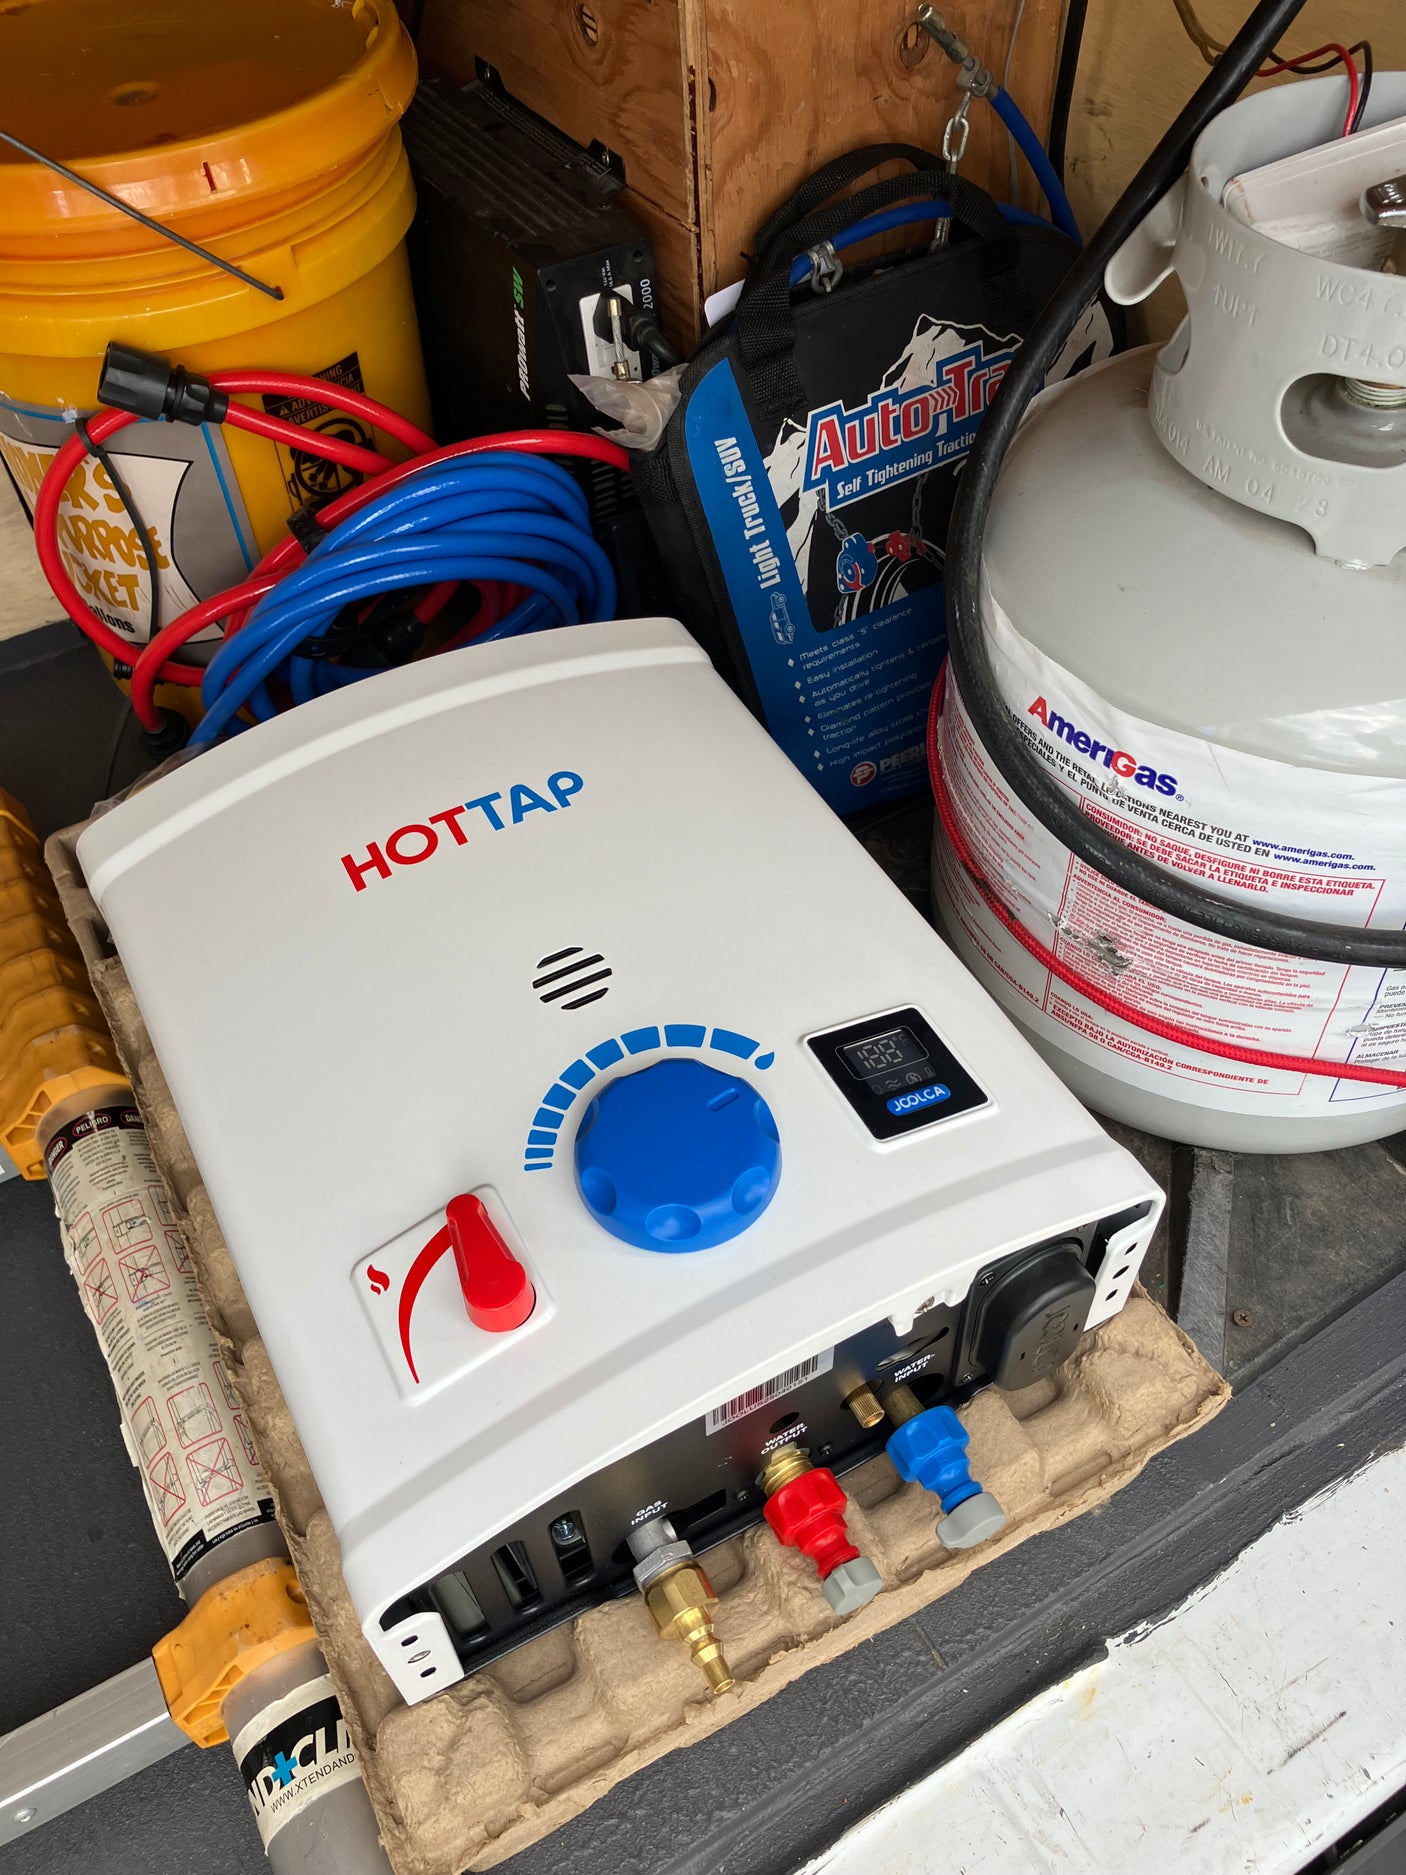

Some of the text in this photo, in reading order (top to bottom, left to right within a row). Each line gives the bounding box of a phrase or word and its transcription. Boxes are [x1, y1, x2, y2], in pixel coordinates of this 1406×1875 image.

[640, 278, 654, 310] 2000
[811, 394, 932, 481] Auto
[836, 476, 862, 499] Self
[866, 449, 933, 487] Tightening
[1203, 456, 1231, 485] AM
[1245, 478, 1274, 504] 04
[714, 436, 782, 590] Light Truck/SUV
[800, 607, 912, 662] Meets class clearance
[803, 641, 861, 670] requirements
[806, 648, 879, 685] Easy installation
[811, 669, 869, 698] Automatically
[870, 653, 906, 672] tightens
[814, 679, 870, 707] as you drive
[817, 698, 863, 719] Eliminates
[820, 713, 862, 733] Diamond
[863, 697, 895, 717] pattern
[822, 724, 858, 741] traction
[868, 725, 889, 739] alloy
[852, 742, 882, 759] impact
[1012, 715, 1038, 740] OFFERS
[1037, 736, 1055, 754] AND
[1055, 750, 1071, 768] THE
[1159, 808, 1208, 832] NEAREST
[1210, 824, 1233, 839] YOU
[1236, 832, 1250, 843] AT
[1252, 838, 1355, 861] www.amerigas.com.
[340, 771, 584, 893] HOTTAP
[1058, 764, 1065, 774] Y
[1067, 768, 1078, 783] EL
[1080, 778, 1109, 802] PUNTO
[1112, 798, 1126, 810] DE
[1127, 805, 1159, 824] VENTA
[1161, 818, 1196, 839] CERCA
[1198, 832, 1213, 844] DE
[1216, 836, 1252, 854] USTED
[1254, 846, 1270, 858] EN
[1273, 852, 1377, 871] www.amerigas.com.
[1084, 810, 1354, 897] PROVEEDOR: SE DEBE SACAR LA ETIQUETA E INSPECCIONAR
[1086, 803, 1376, 891] CONSUMIDOR: NO SAQUE, DESFIGURE NI BORRE ESTA ETIQUETA.
[1088, 872, 1098, 882] USE
[1127, 841, 1155, 860] ANTES
[1156, 854, 1169, 865] DE
[1171, 858, 1205, 879] VOLVER
[1218, 876, 1269, 894] LLENARLO.
[1072, 874, 1112, 899] ADVERTENCIA
[1051, 1010, 1088, 1035] ANSI/NFPA
[1088, 1031, 1098, 1041] 58
[1107, 1041, 1172, 1070] CAN/CGA-B149.2
[1052, 1004, 1083, 1026] EXCEPTO
[1084, 1022, 1104, 1037] BAJO
[1105, 1032, 1115, 1042] LA
[1116, 1037, 1174, 1065] AUTORIZACIÓN
[1175, 1061, 1255, 1084] CORRESPONDIENTE
[894, 1086, 946, 1112] JOOLCA
[894, 1360, 929, 1383] INPUT
[761, 1426, 808, 1455] OUTPUT
[765, 1422, 806, 1448] WATER
[631, 1502, 669, 1526] INPUT
[636, 1500, 662, 1516] GAS
[270, 1753, 356, 1814] WWW.XTENDAND
